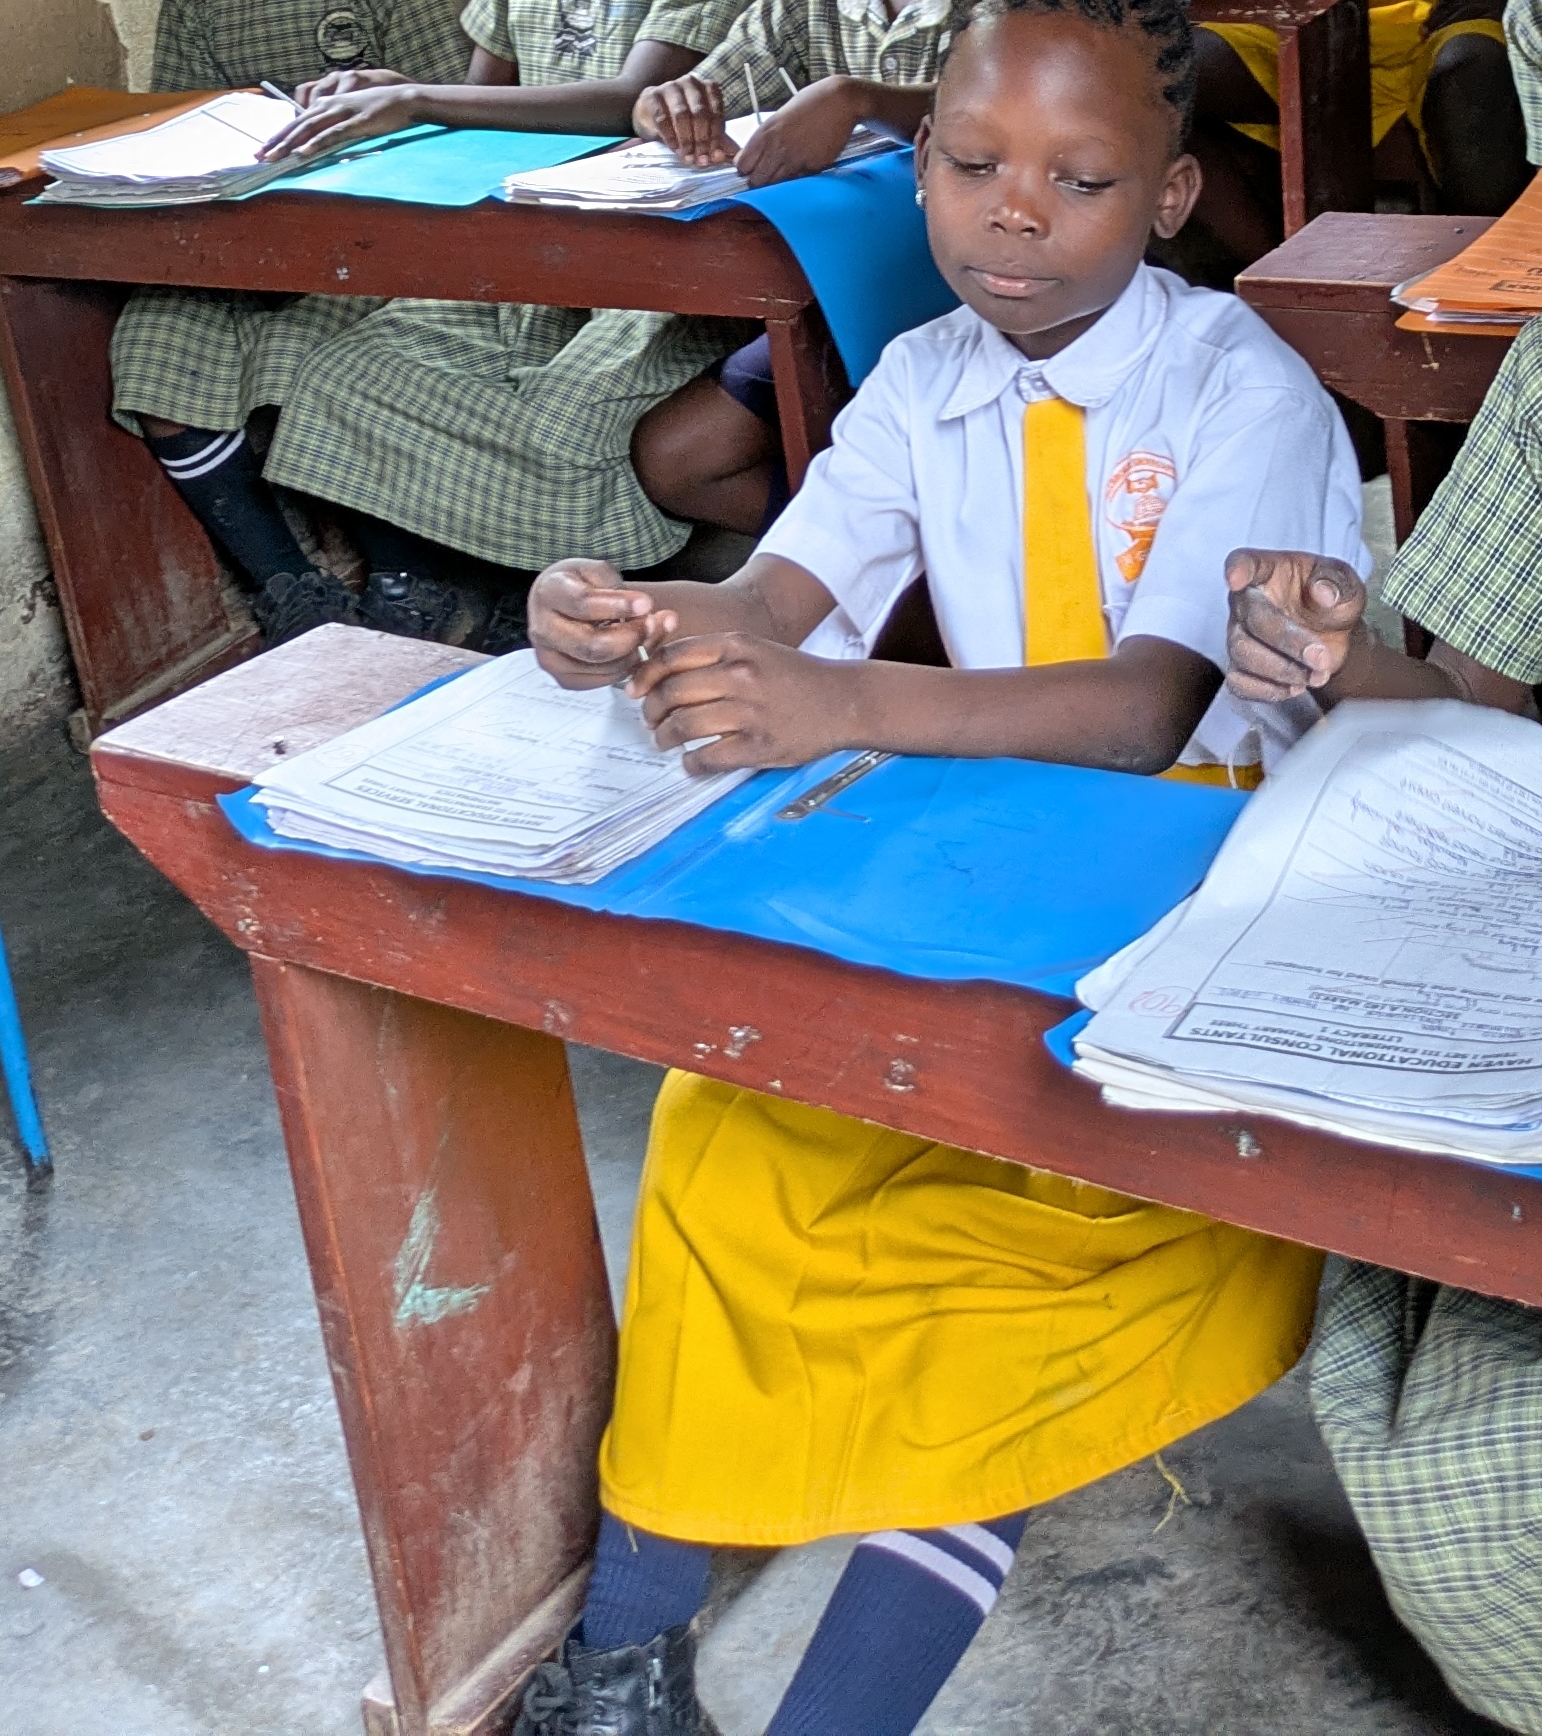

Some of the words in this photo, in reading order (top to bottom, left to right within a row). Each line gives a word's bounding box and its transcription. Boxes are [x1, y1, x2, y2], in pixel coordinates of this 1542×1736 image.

[355, 783, 415, 805] SERVICES
[1189, 1026, 1323, 1052] CONSULTANTS
[1331, 1027, 1404, 1043] LITERACY
[1328, 1045, 1462, 1070] EDUCATIONAL
